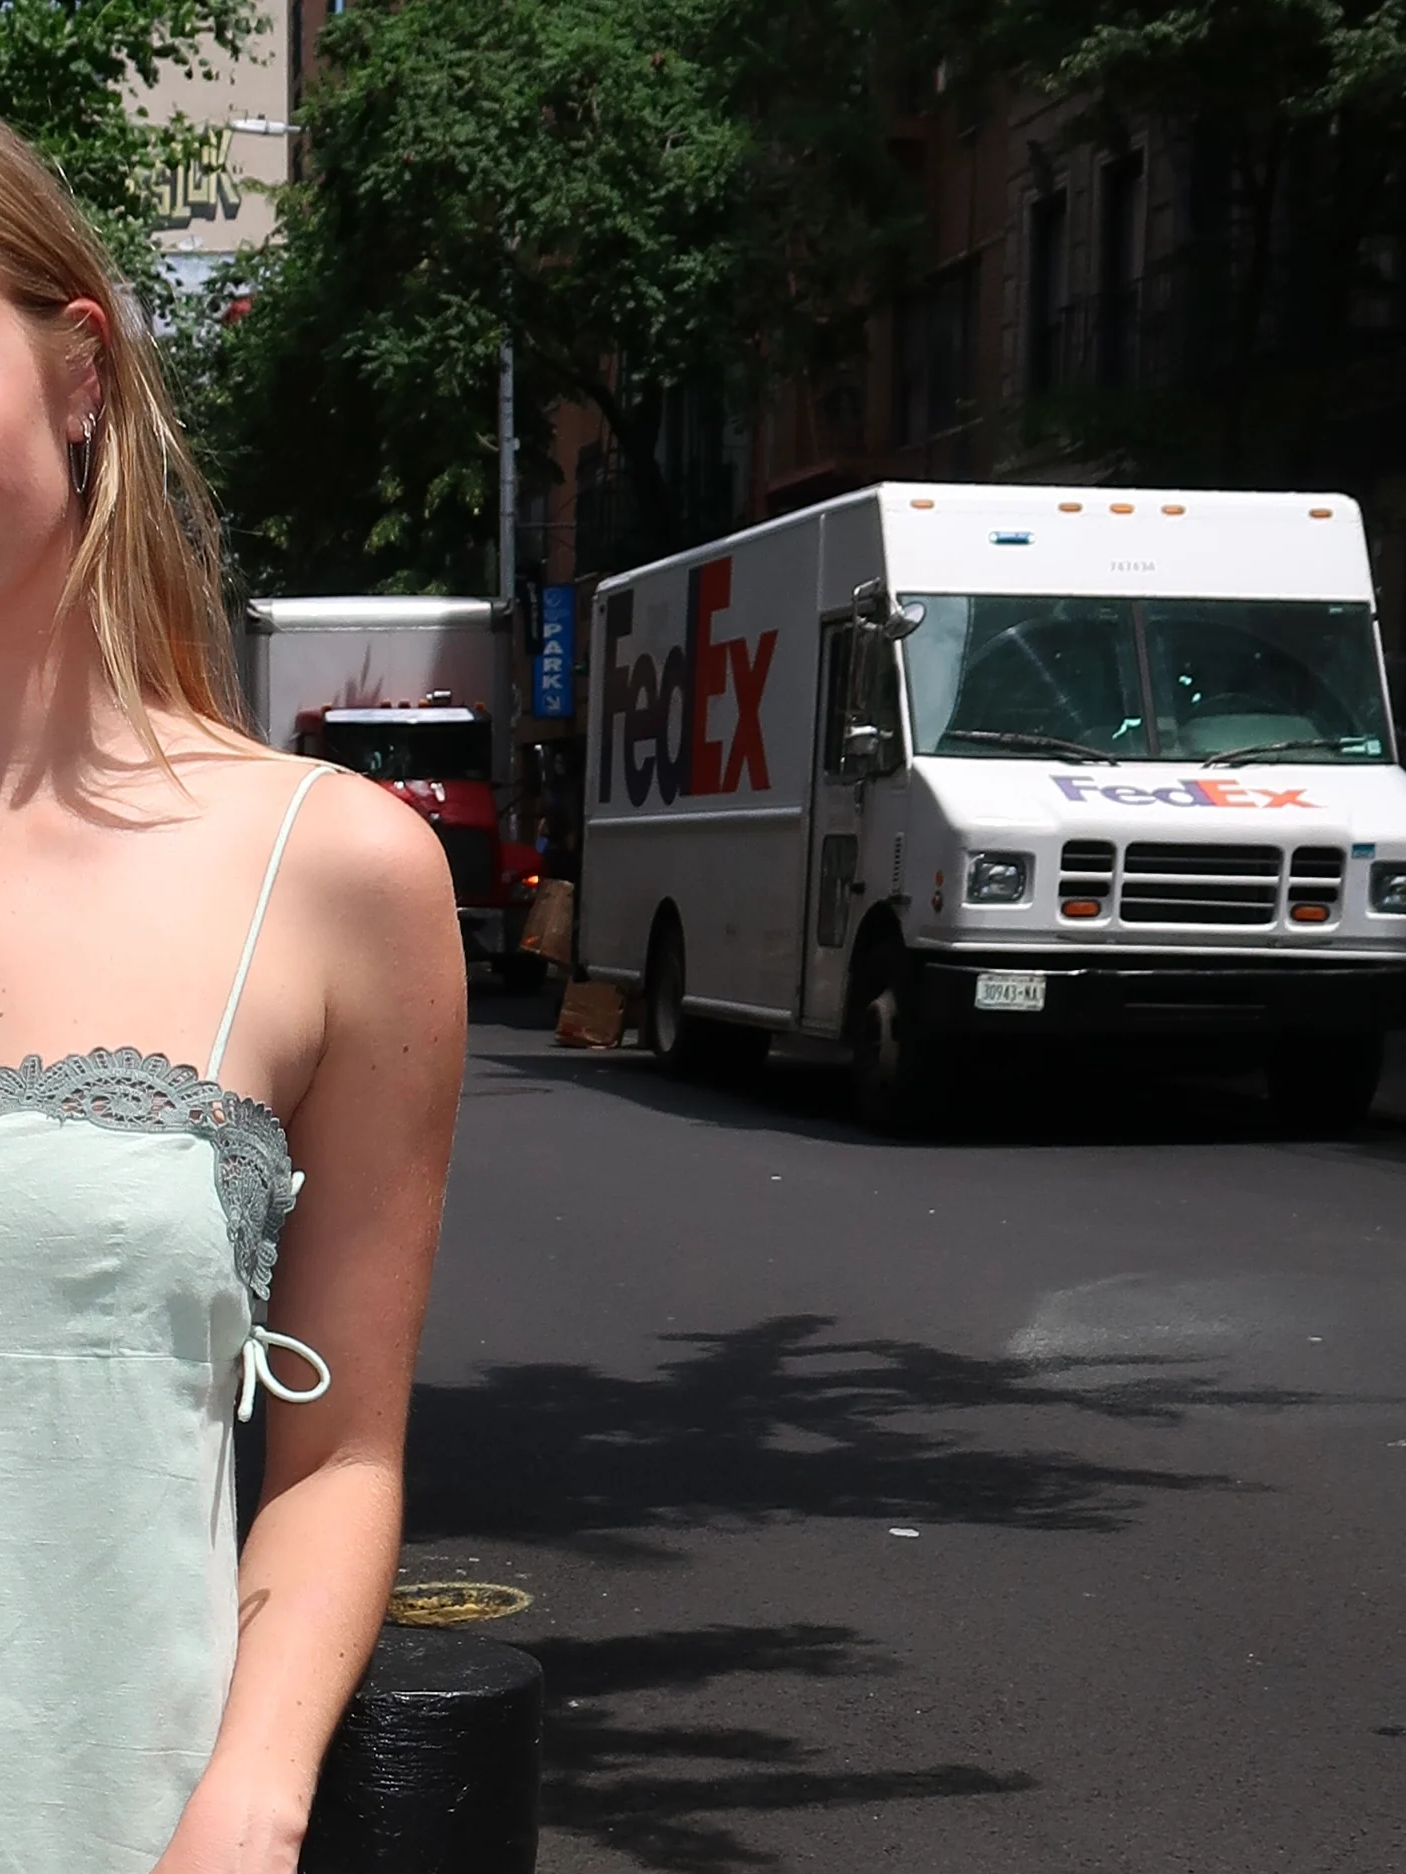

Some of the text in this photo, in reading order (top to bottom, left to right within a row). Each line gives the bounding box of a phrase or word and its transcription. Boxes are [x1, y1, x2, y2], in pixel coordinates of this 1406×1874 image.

[542, 623, 563, 689] PARK
[599, 556, 779, 807] FedEx
[1048, 774, 1329, 808] FedEx
